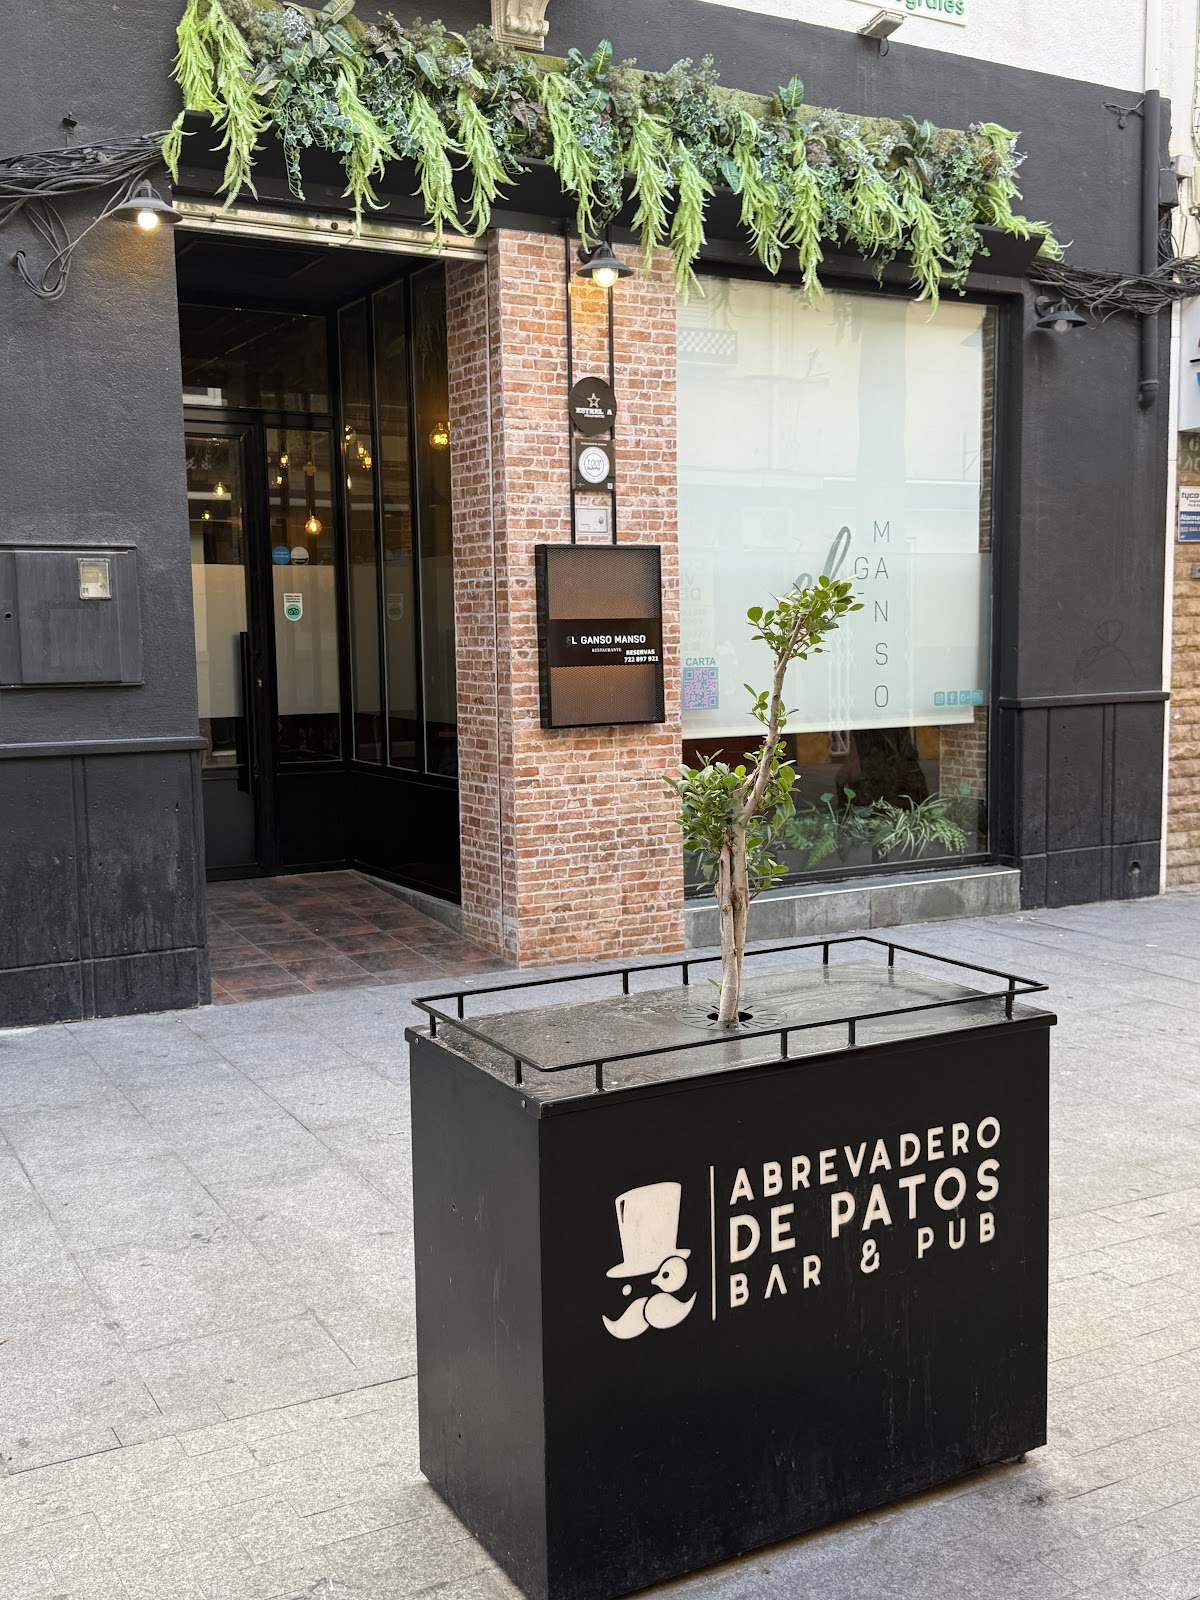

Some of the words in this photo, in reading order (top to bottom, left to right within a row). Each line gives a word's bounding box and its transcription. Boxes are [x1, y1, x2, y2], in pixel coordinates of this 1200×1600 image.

[580, 635, 613, 645] GANSO
[614, 634, 647, 644] MANSO
[625, 648, 656, 656] RESERVAS
[685, 657, 717, 667] CARTA
[729, 1115, 1001, 1206] ABREVADERO
[729, 1203, 797, 1264] DE
[830, 1157, 1001, 1239] PATOS
[729, 1253, 823, 1309] BAR
[859, 1237, 881, 1275] &
[916, 1210, 997, 1260] PUB
